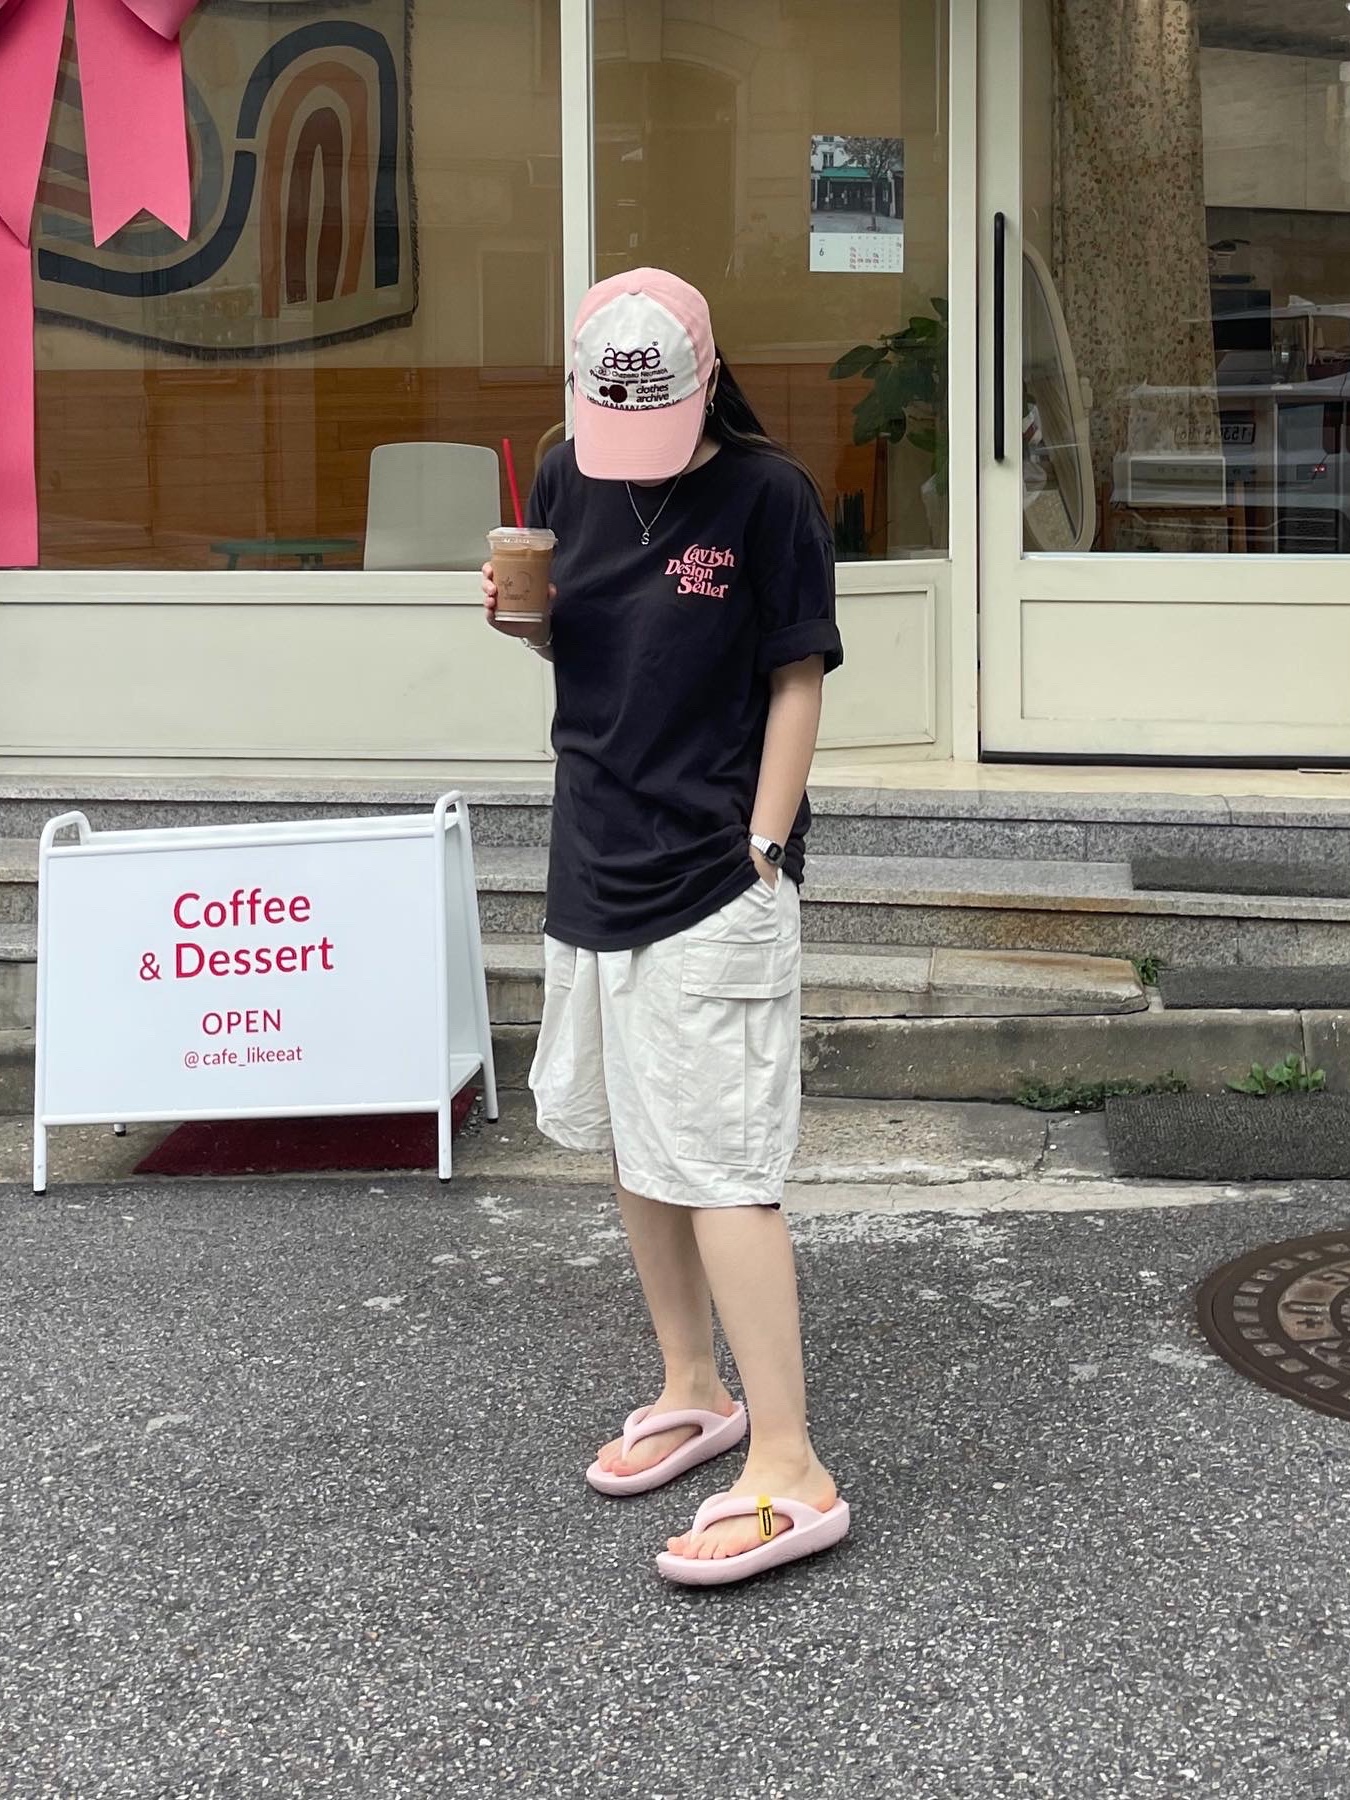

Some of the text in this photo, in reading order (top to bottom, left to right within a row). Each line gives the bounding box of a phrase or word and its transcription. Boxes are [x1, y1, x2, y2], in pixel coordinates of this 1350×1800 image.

[636, 384, 669, 395] clothes
[636, 393, 670, 403] archive
[664, 558, 713, 583] Design
[677, 575, 729, 598] Seller
[173, 888, 311, 930] Coffee
[139, 936, 334, 981] & Dessert
[202, 1008, 281, 1036] OPEN
